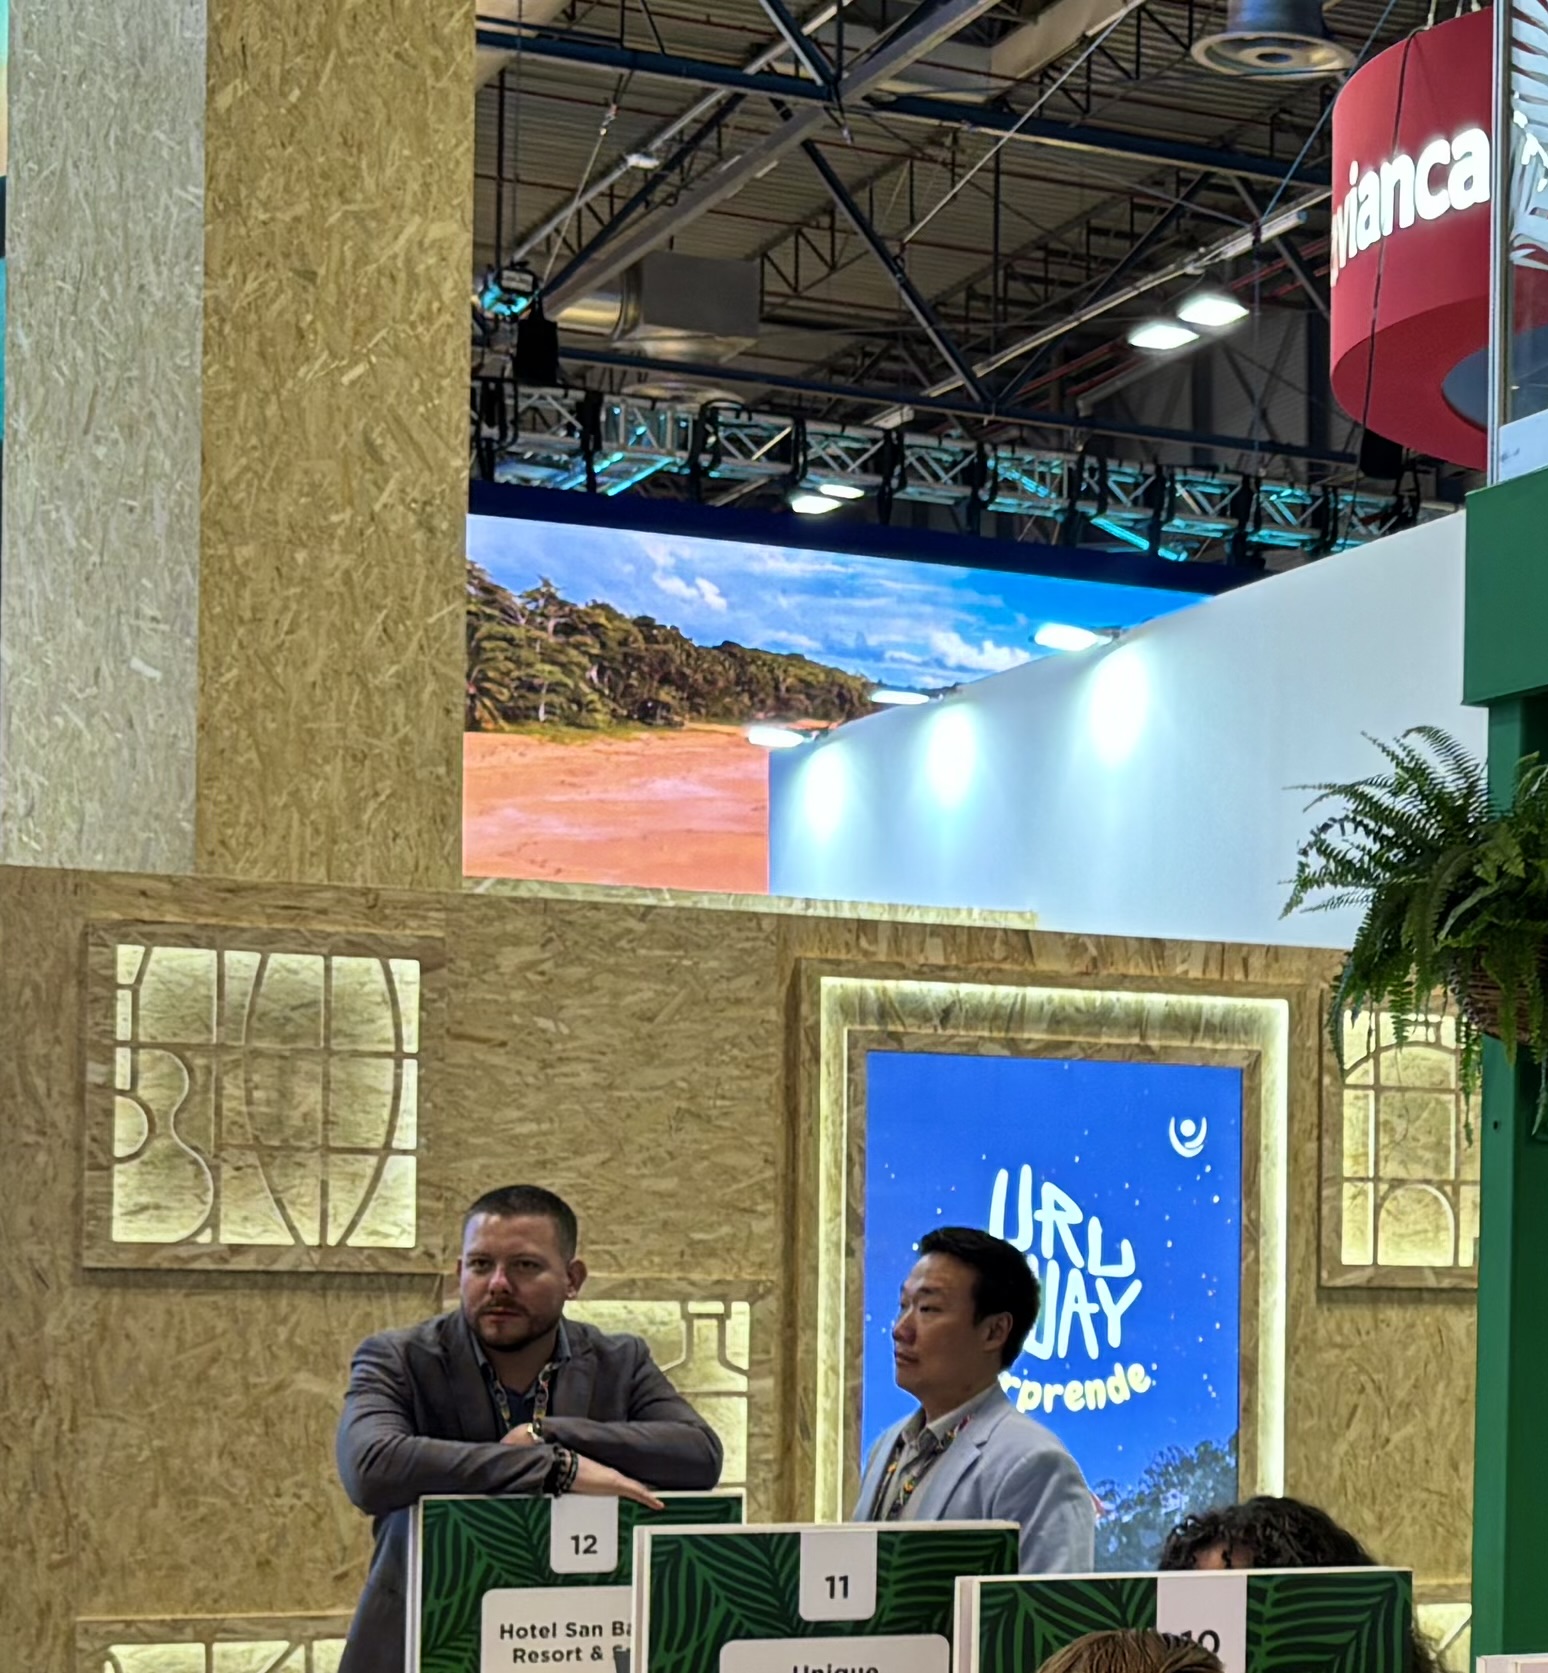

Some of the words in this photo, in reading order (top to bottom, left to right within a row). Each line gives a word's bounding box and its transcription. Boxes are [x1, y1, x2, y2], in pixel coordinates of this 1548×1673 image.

[1024, 1254, 1143, 1361] UAY
[998, 1362, 1152, 1414] rprende
[570, 1534, 599, 1556] 12
[824, 1574, 850, 1600] 11
[499, 1621, 557, 1640] Hotel
[565, 1621, 603, 1638] San
[512, 1646, 583, 1664] Resort
[590, 1645, 604, 1661] &
